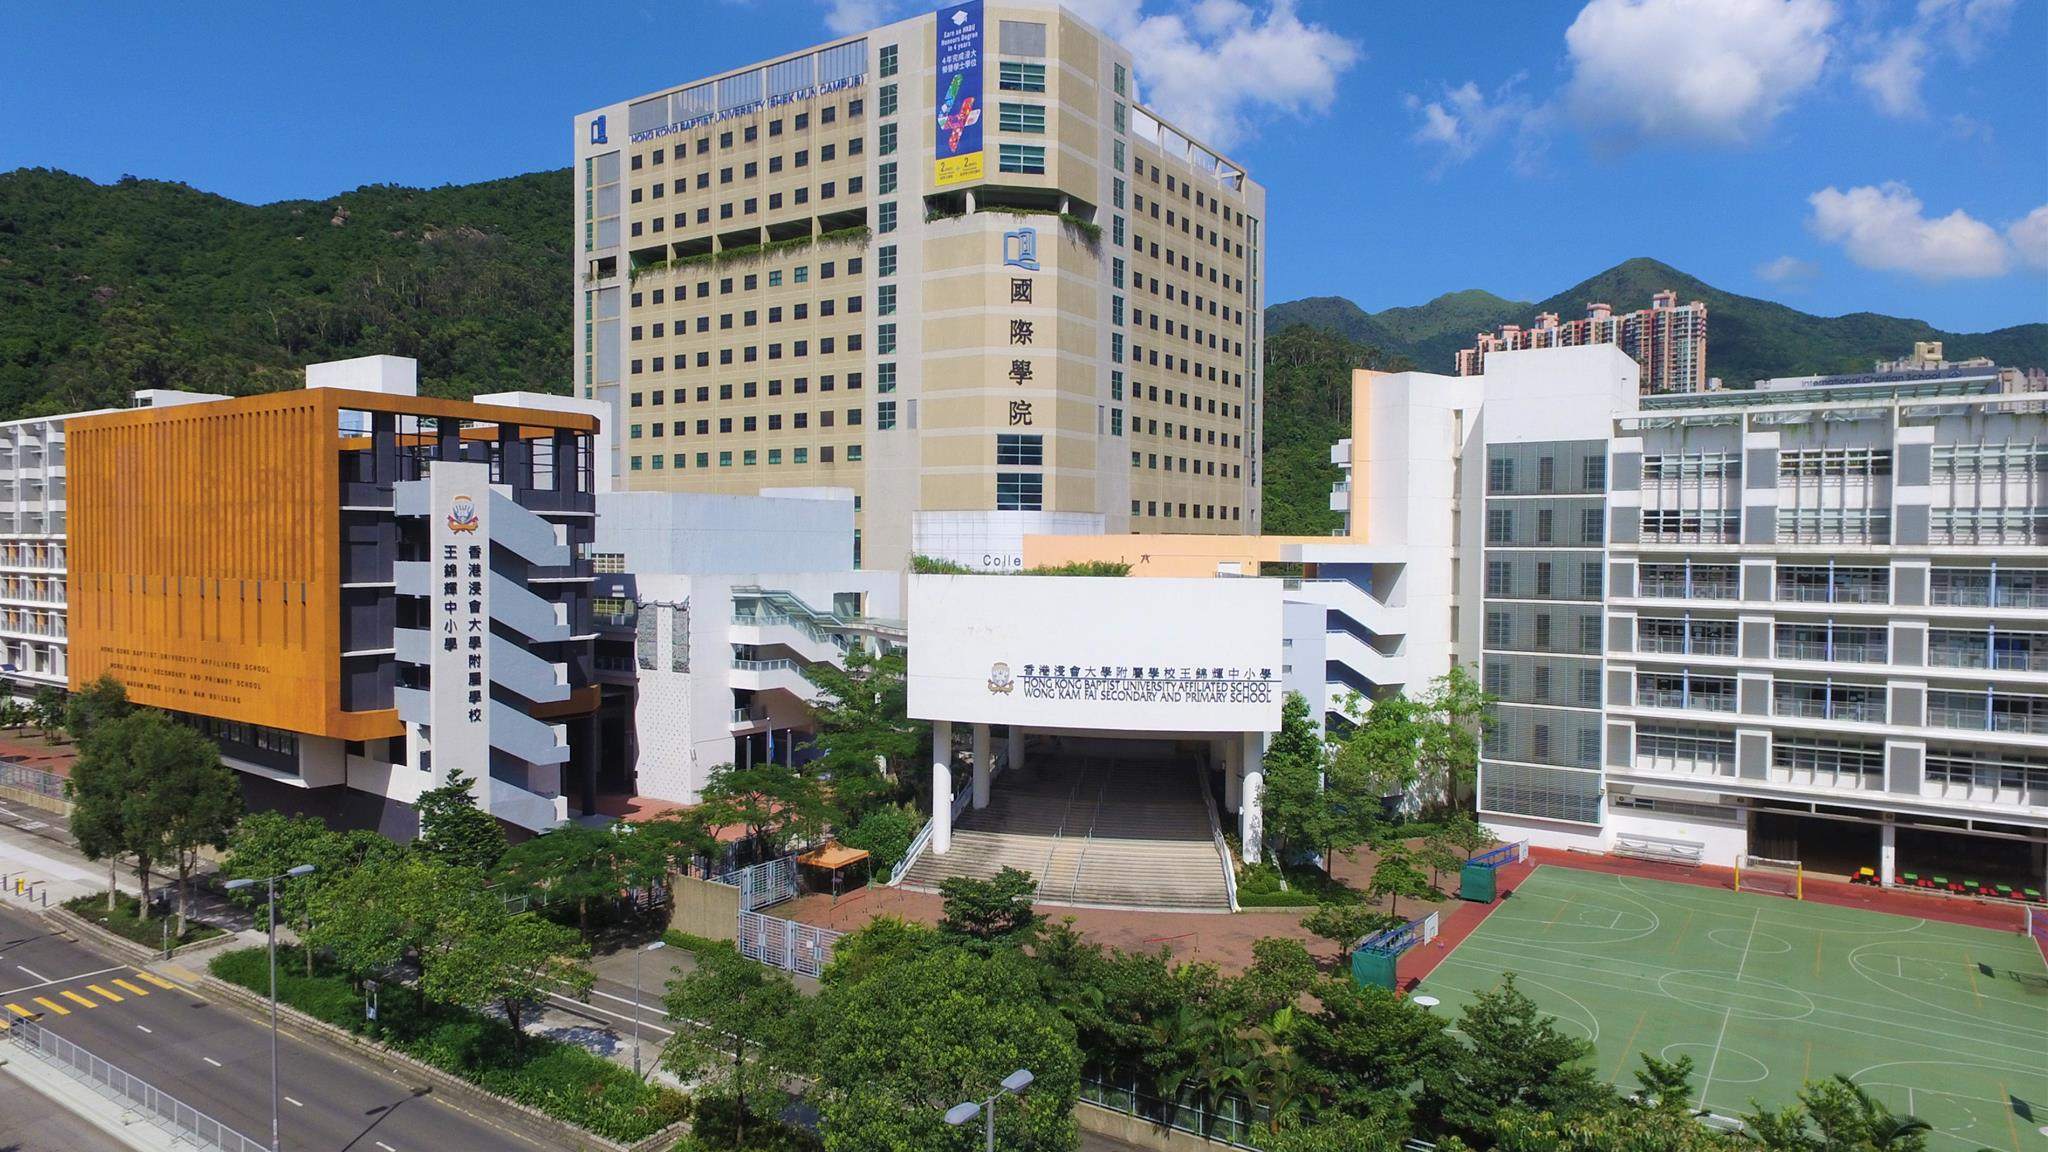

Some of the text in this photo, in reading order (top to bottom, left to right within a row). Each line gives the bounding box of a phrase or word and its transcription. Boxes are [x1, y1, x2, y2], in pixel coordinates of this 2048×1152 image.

[631, 129, 654, 143] HONG
[655, 123, 679, 138] KONG
[680, 112, 714, 131] BAPTIST
[715, 99, 765, 123] UNIVERSITY
[797, 86, 816, 101] MUN
[1009, 277, 1034, 426] 國際學院
[1801, 377, 1860, 387] International
[444, 545, 458, 652] 王錦輝中小學
[468, 545, 482, 723] 香港浸會大學附屬學校
[244, 664, 271, 673] SCHOOL
[1024, 677, 1271, 693] HONG KONG BAPTIST UNIVERSITY AFFILIATED SCHOOL
[1024, 688, 1271, 703] WONG KAM FAI SECONDARY AND PRIMARY SCHOOL
